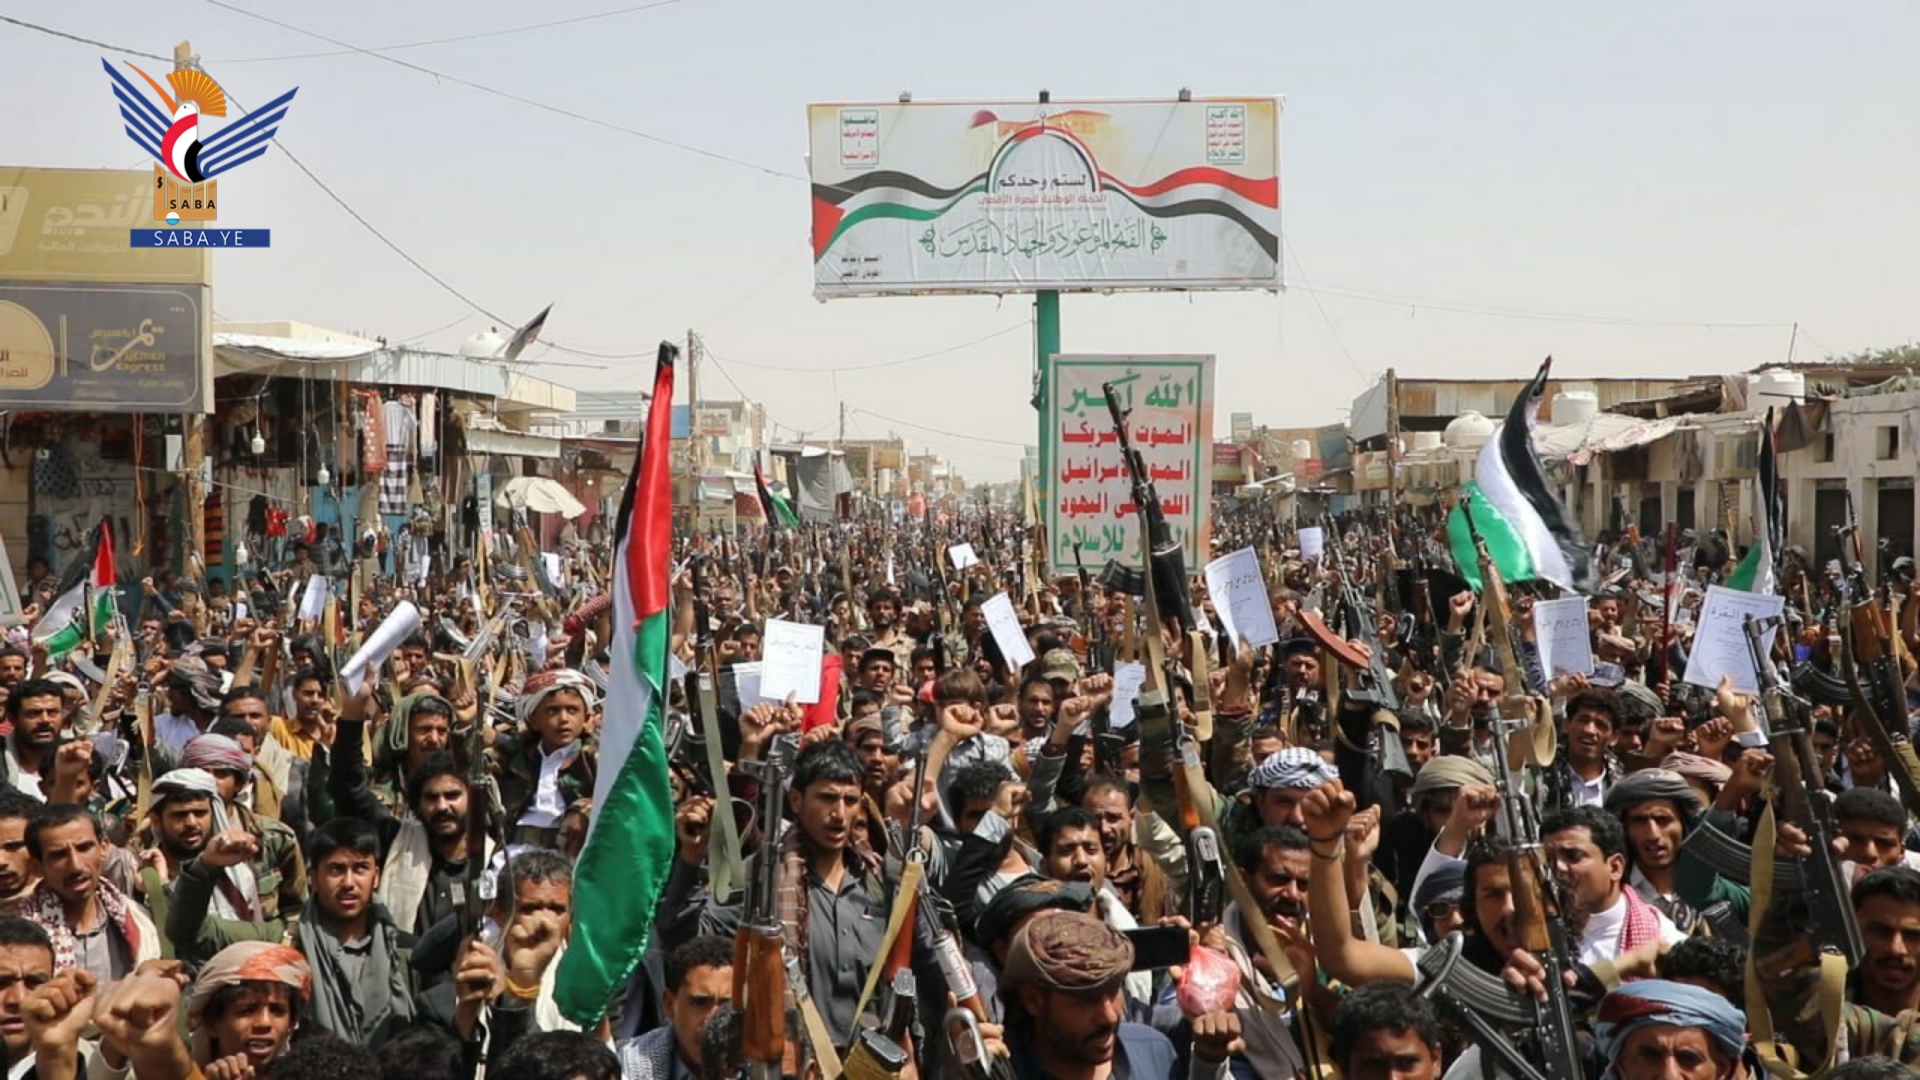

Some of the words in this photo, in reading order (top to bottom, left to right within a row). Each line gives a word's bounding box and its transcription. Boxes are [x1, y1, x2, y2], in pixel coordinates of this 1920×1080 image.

[998, 173, 1048, 191] وحدكم
[1051, 173, 1086, 188] لستم
[1062, 368, 1141, 418] أكبر
[1144, 373, 1194, 408] الله
[1136, 422, 1191, 448] الموت
[1150, 458, 1190, 483] المو
[1060, 491, 1108, 519] اليهود
